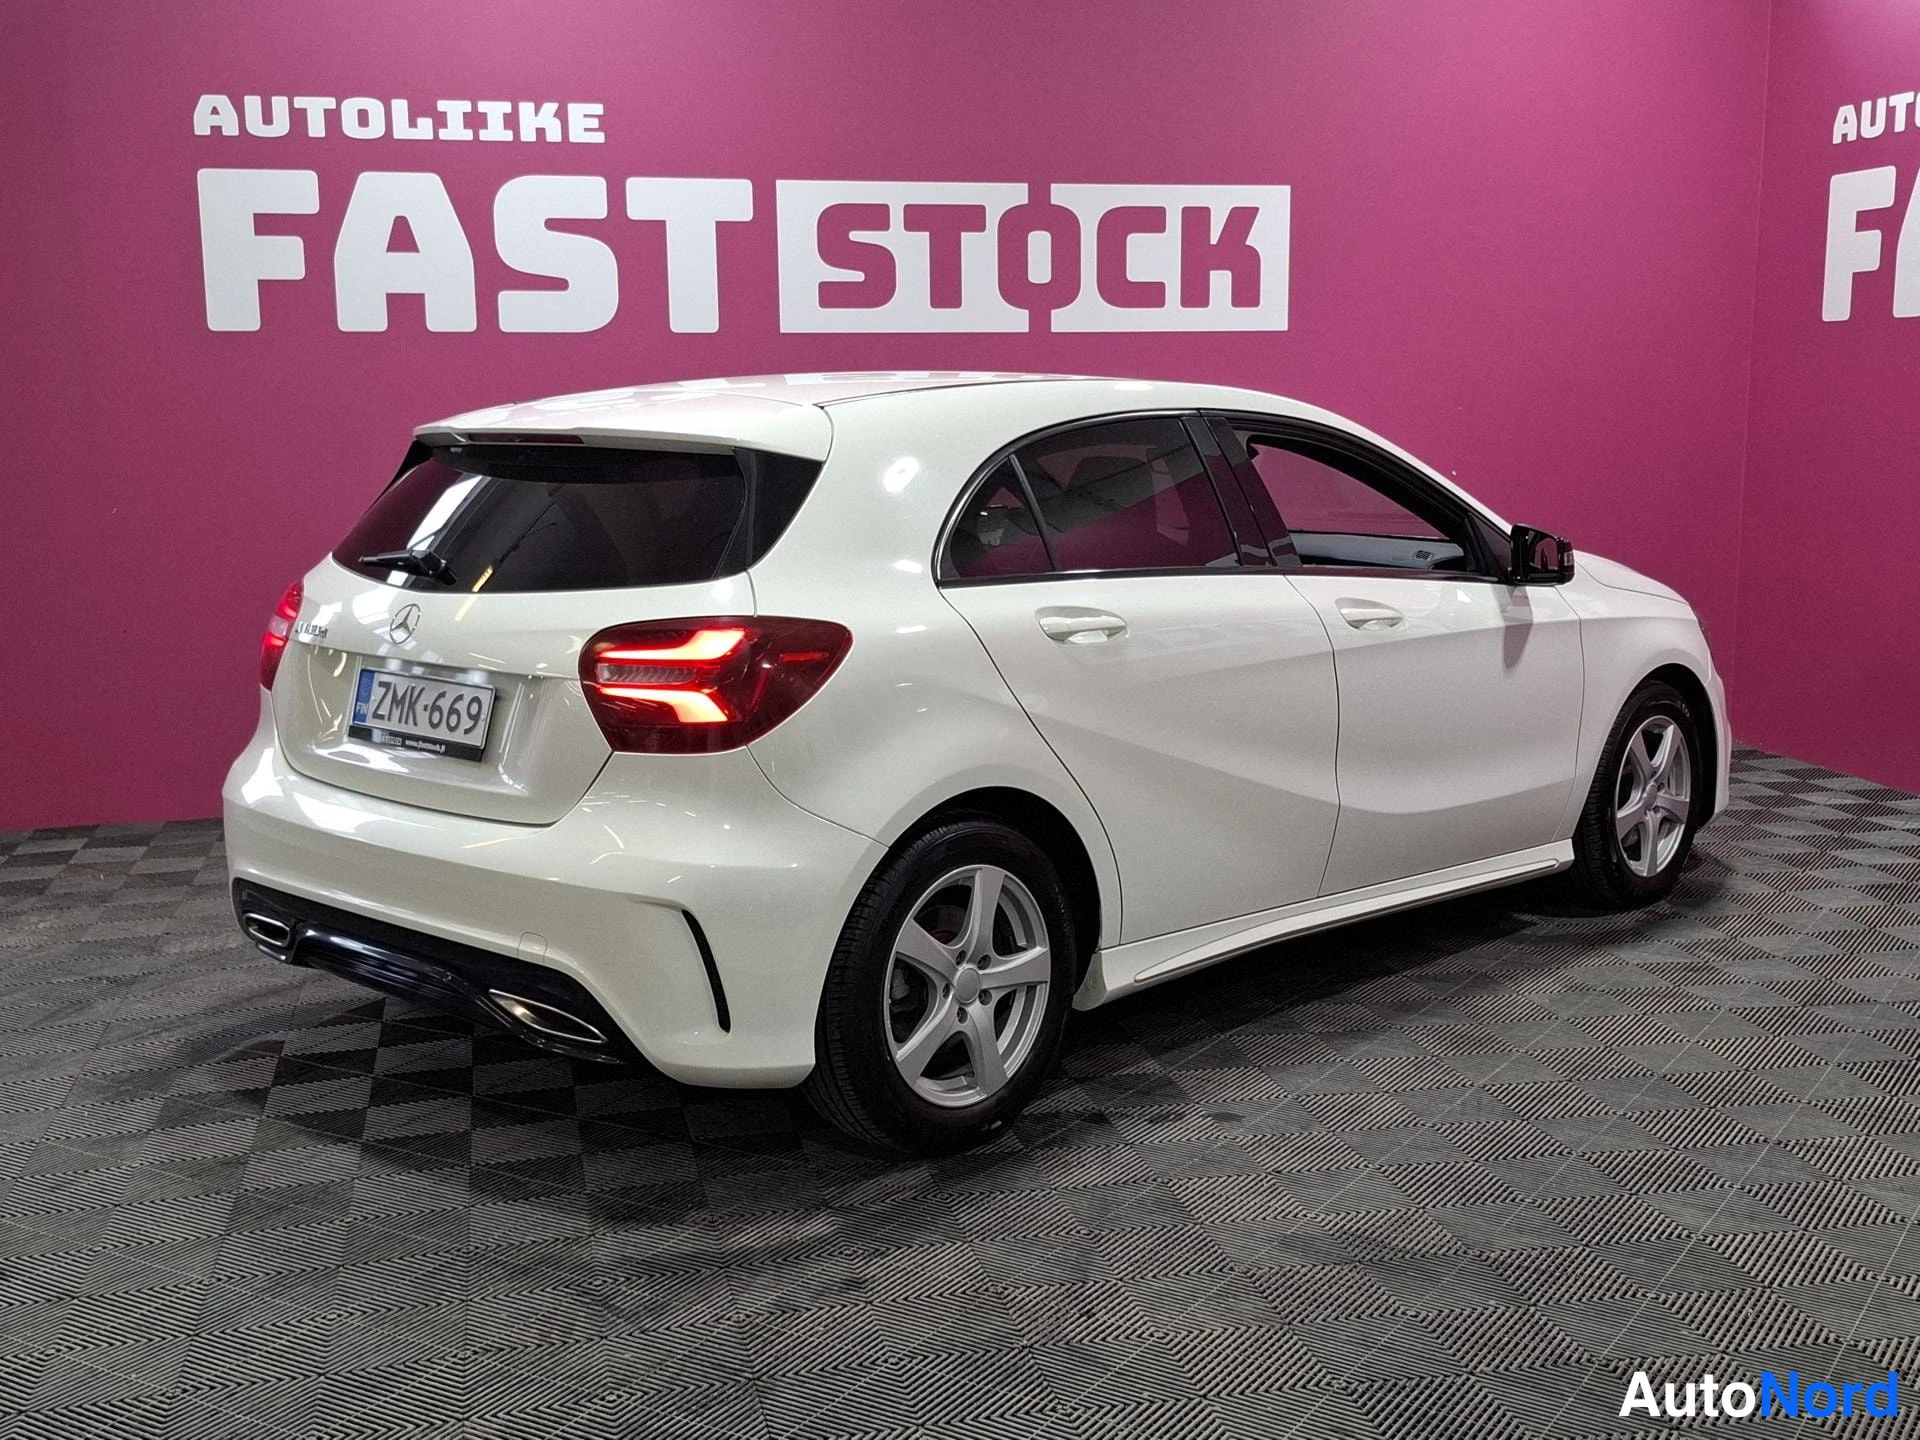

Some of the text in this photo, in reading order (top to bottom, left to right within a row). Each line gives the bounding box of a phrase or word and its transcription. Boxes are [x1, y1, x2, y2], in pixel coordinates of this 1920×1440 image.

[193, 94, 606, 143] AUTOLIIKE
[1832, 91, 1920, 145] AUT
[197, 168, 1262, 333] FAST STOCK
[356, 702, 369, 714] FIN
[372, 681, 483, 735] ZMK-669
